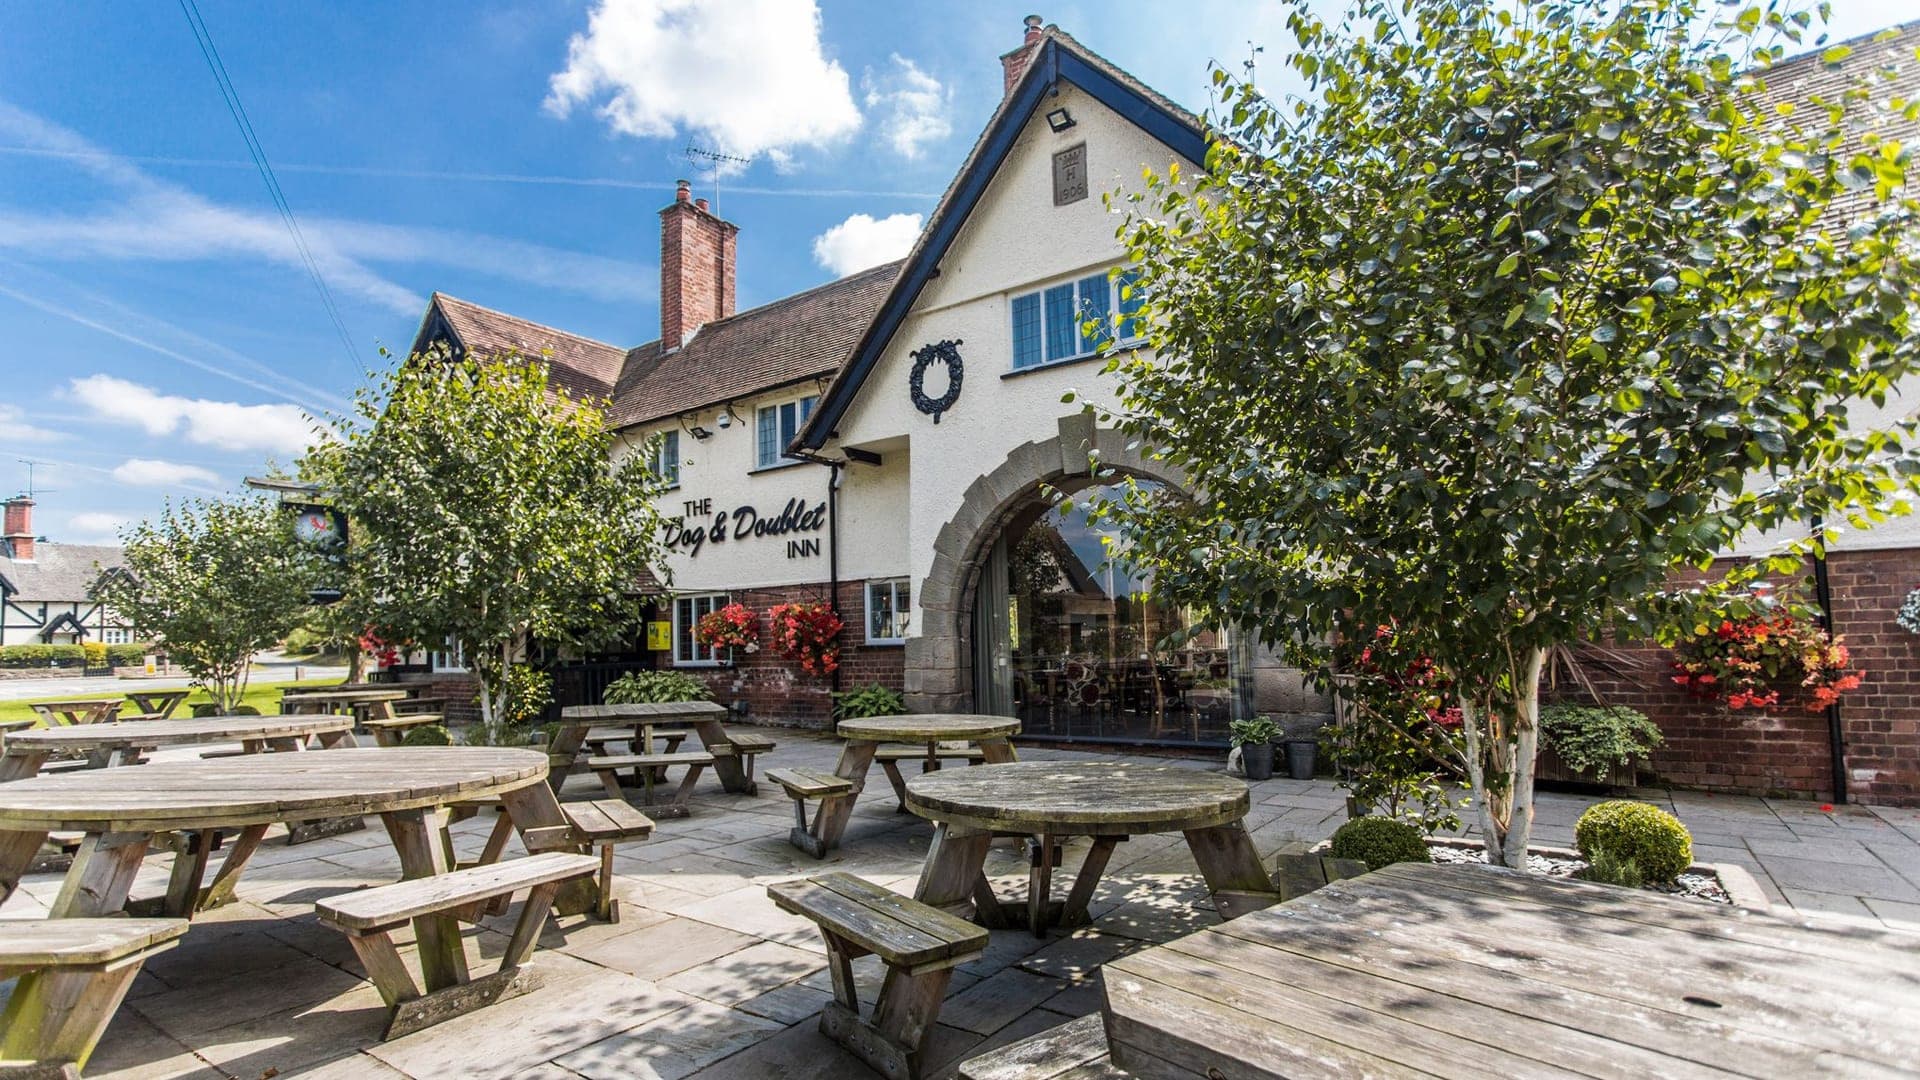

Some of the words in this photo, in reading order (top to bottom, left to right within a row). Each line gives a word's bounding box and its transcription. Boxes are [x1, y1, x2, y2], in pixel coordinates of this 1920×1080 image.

[683, 498, 712, 517] THE
[661, 516, 707, 558] Dog
[709, 511, 728, 544] &
[732, 497, 826, 540] Doublet
[787, 538, 820, 559] INN
